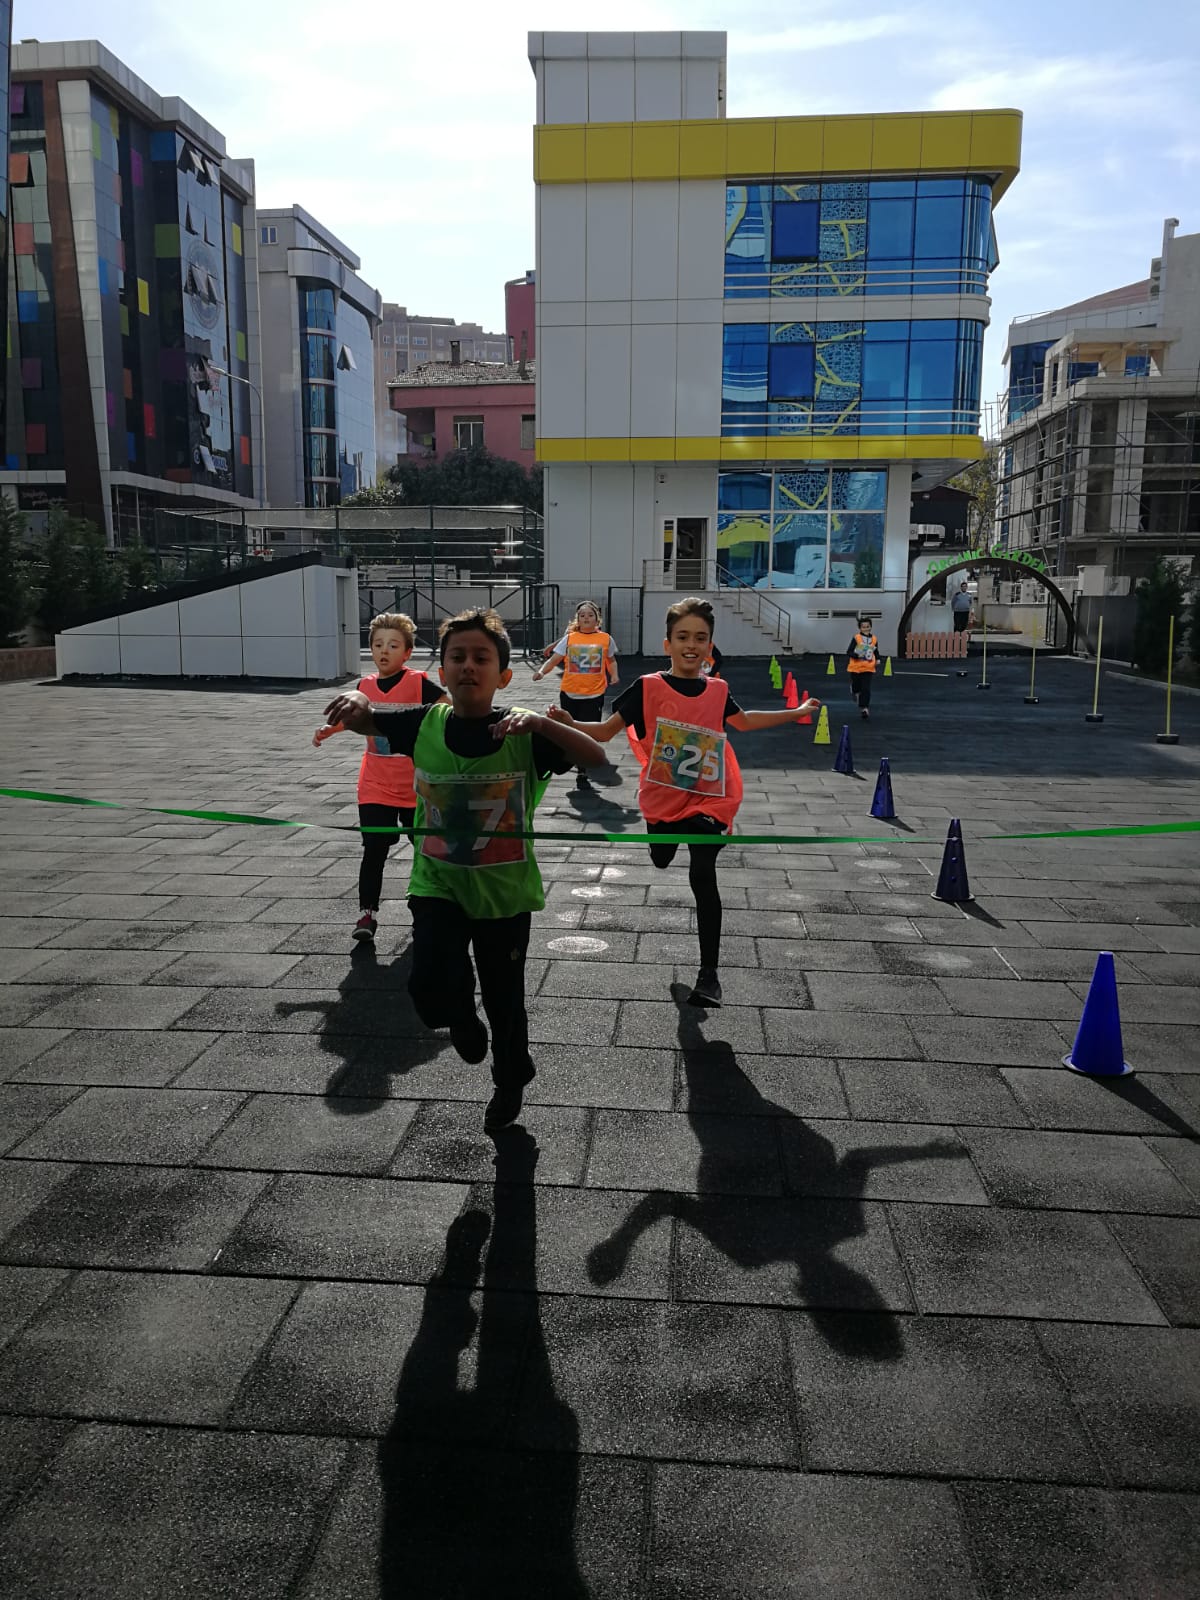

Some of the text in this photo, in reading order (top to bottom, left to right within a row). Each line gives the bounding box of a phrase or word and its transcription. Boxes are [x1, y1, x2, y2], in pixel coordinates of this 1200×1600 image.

[579, 653, 601, 668] 22
[677, 744, 720, 782] 25
[468, 799, 507, 851] 7
